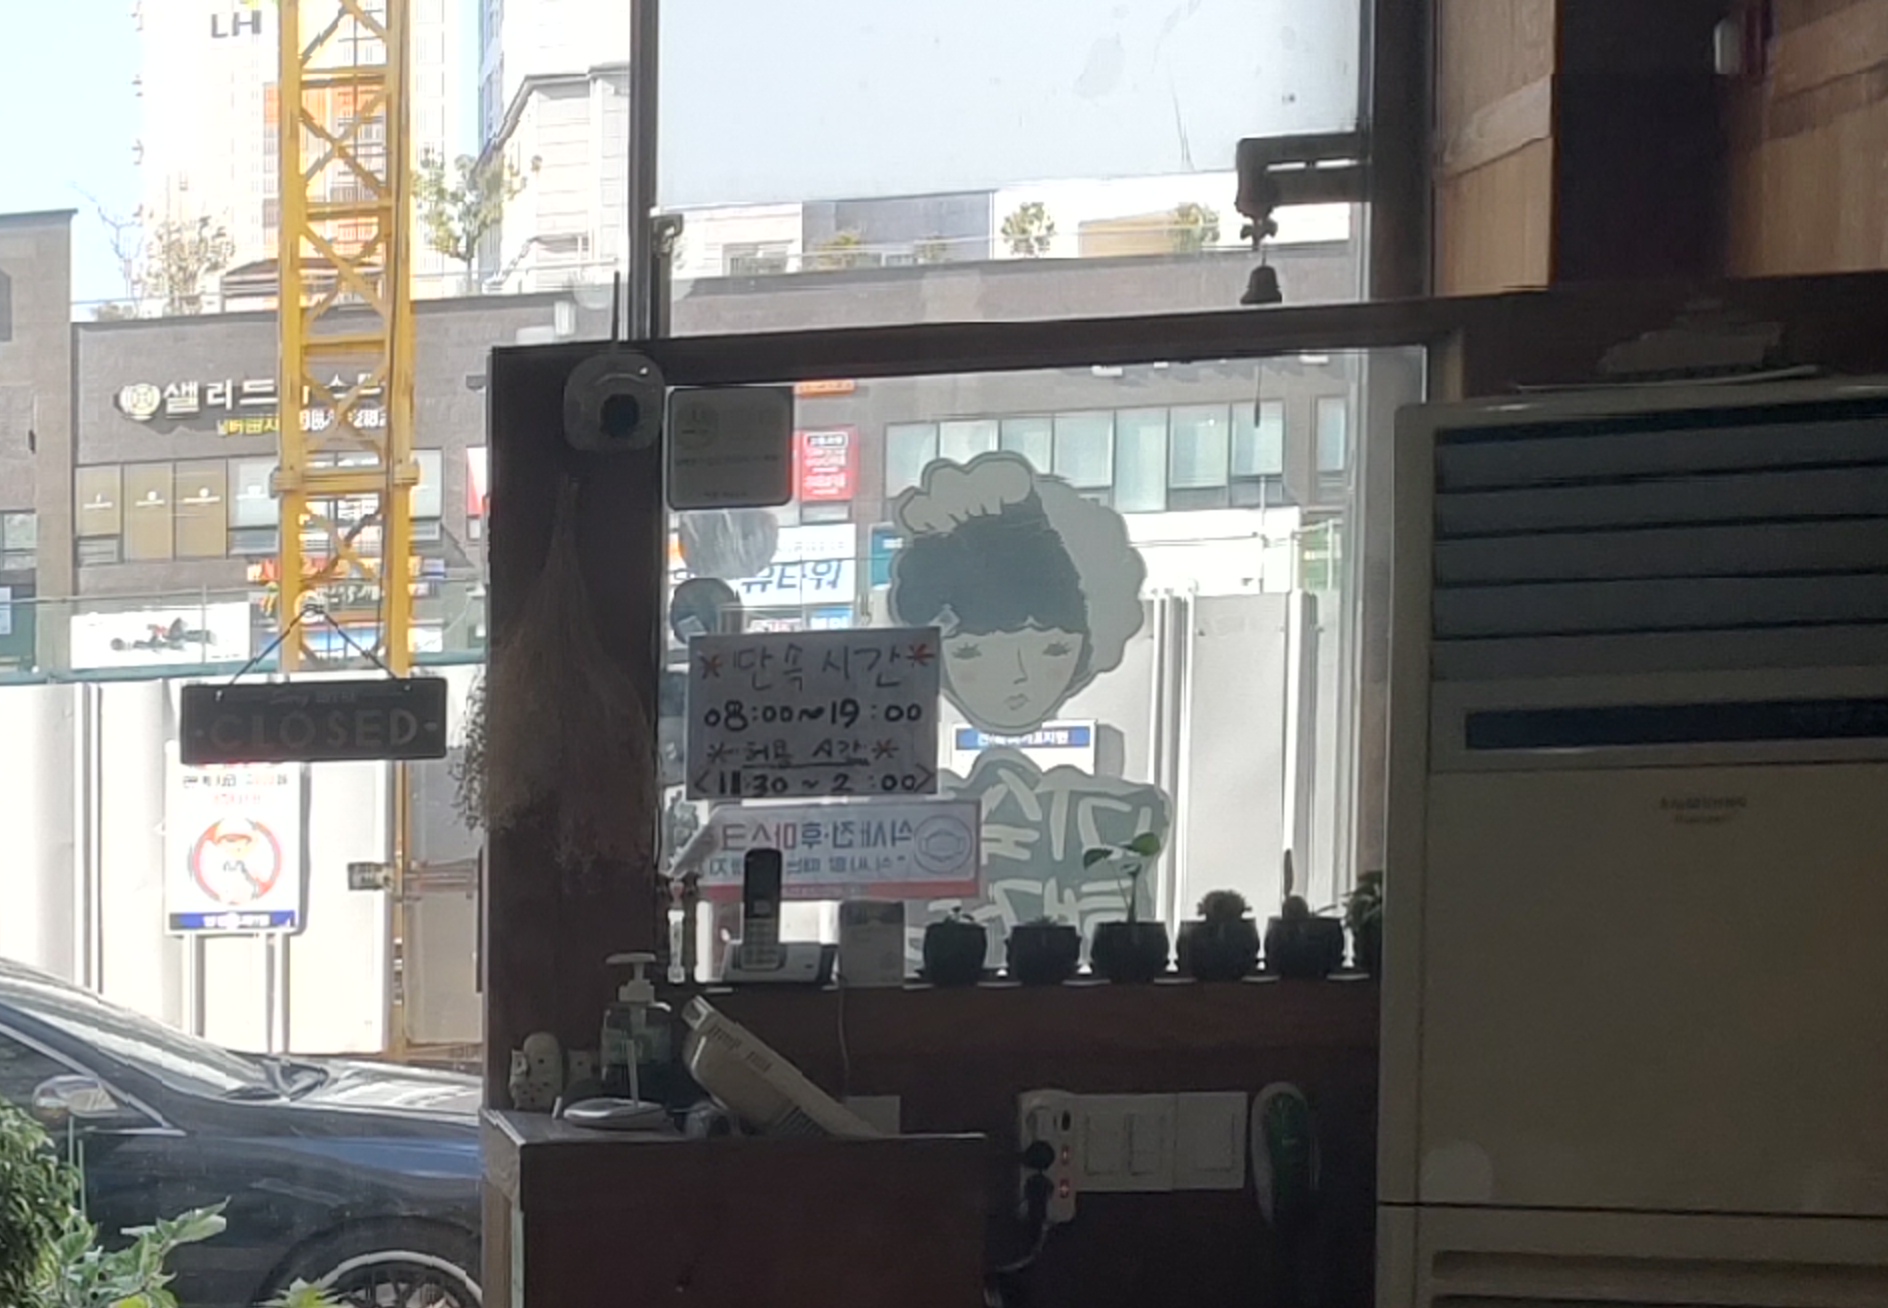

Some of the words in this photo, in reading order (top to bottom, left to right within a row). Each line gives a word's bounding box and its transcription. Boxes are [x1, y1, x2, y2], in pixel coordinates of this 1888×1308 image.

[210, 9, 262, 39] LH
[733, 643, 804, 692] 단속
[822, 645, 901, 688] 시간
[209, 708, 419, 751] CLOSED
